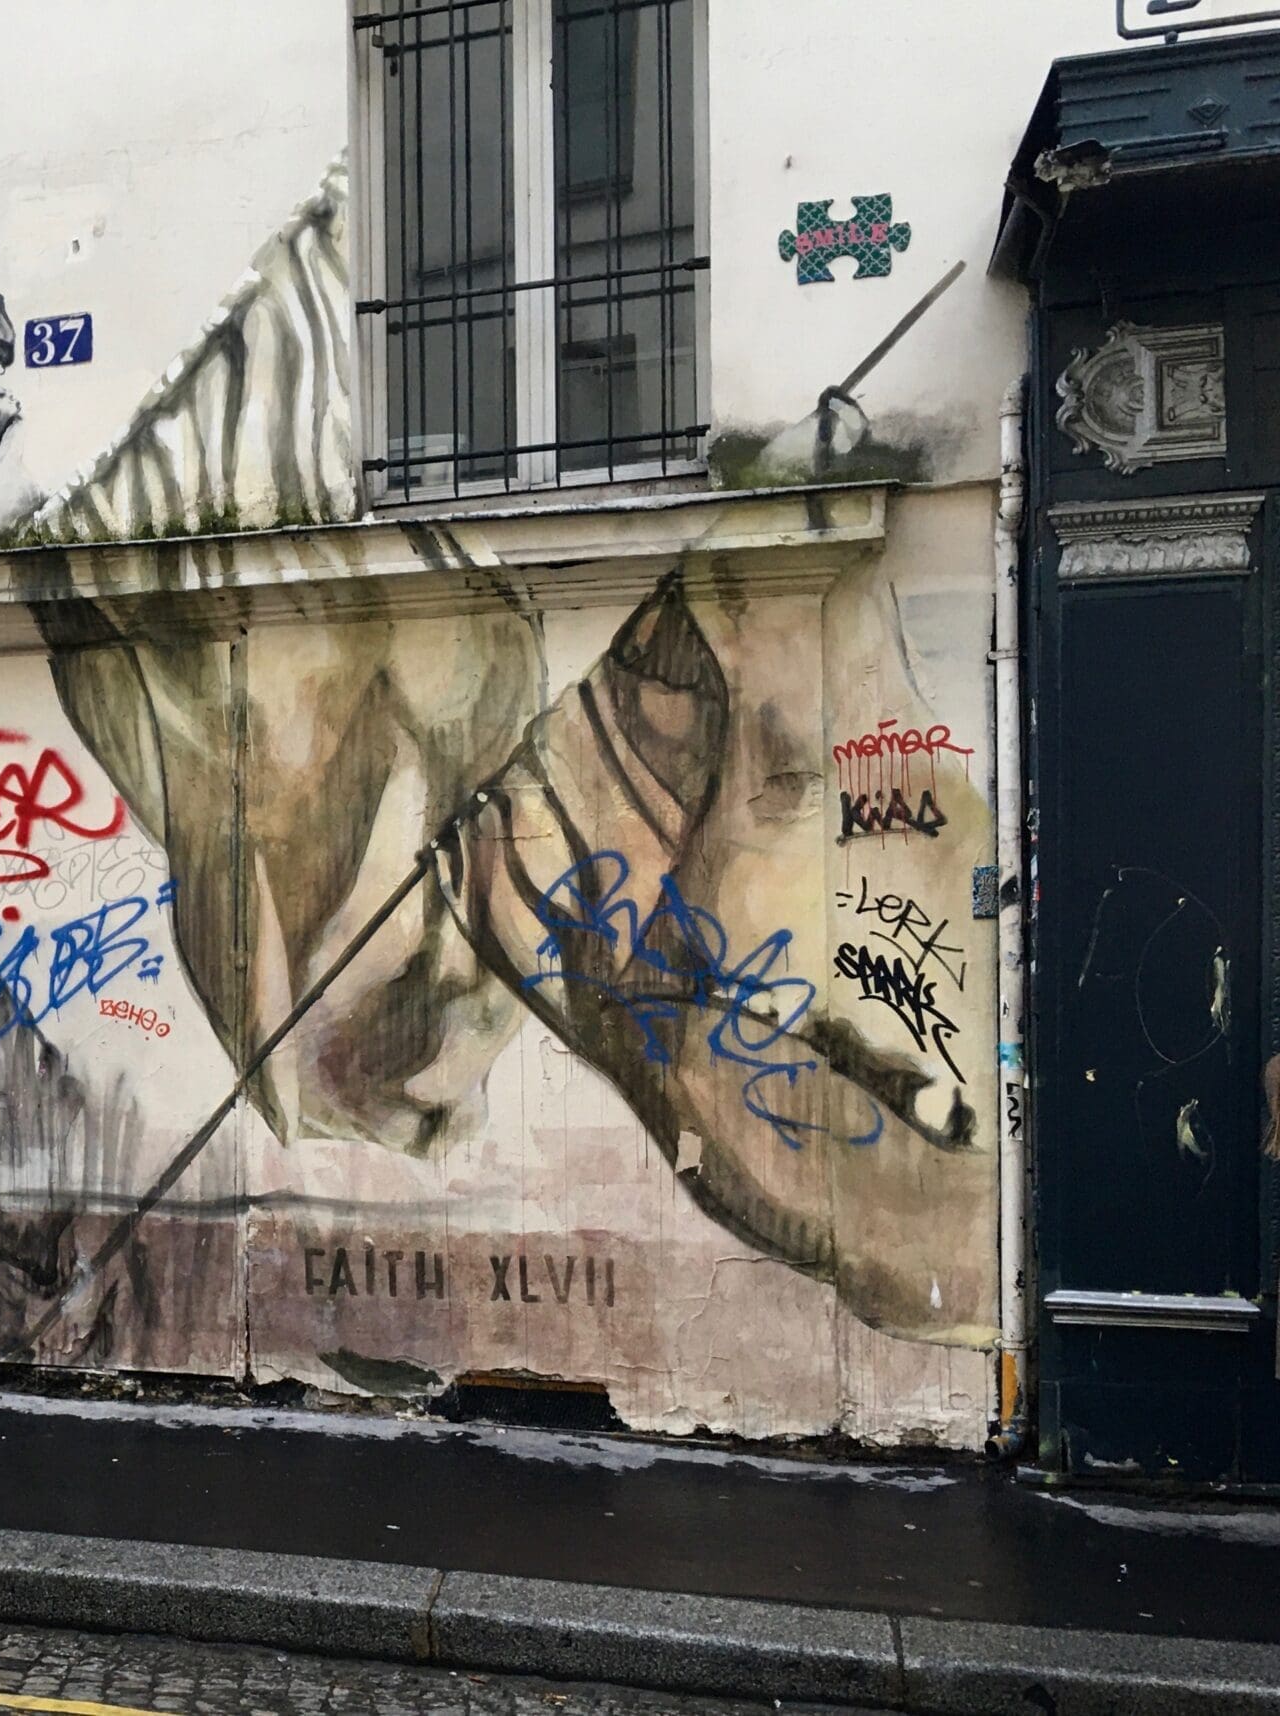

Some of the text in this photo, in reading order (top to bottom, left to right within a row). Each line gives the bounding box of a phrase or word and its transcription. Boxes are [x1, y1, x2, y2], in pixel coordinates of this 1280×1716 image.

[31, 317, 85, 365] 37
[305, 1246, 615, 1308] FAITH XLVII
